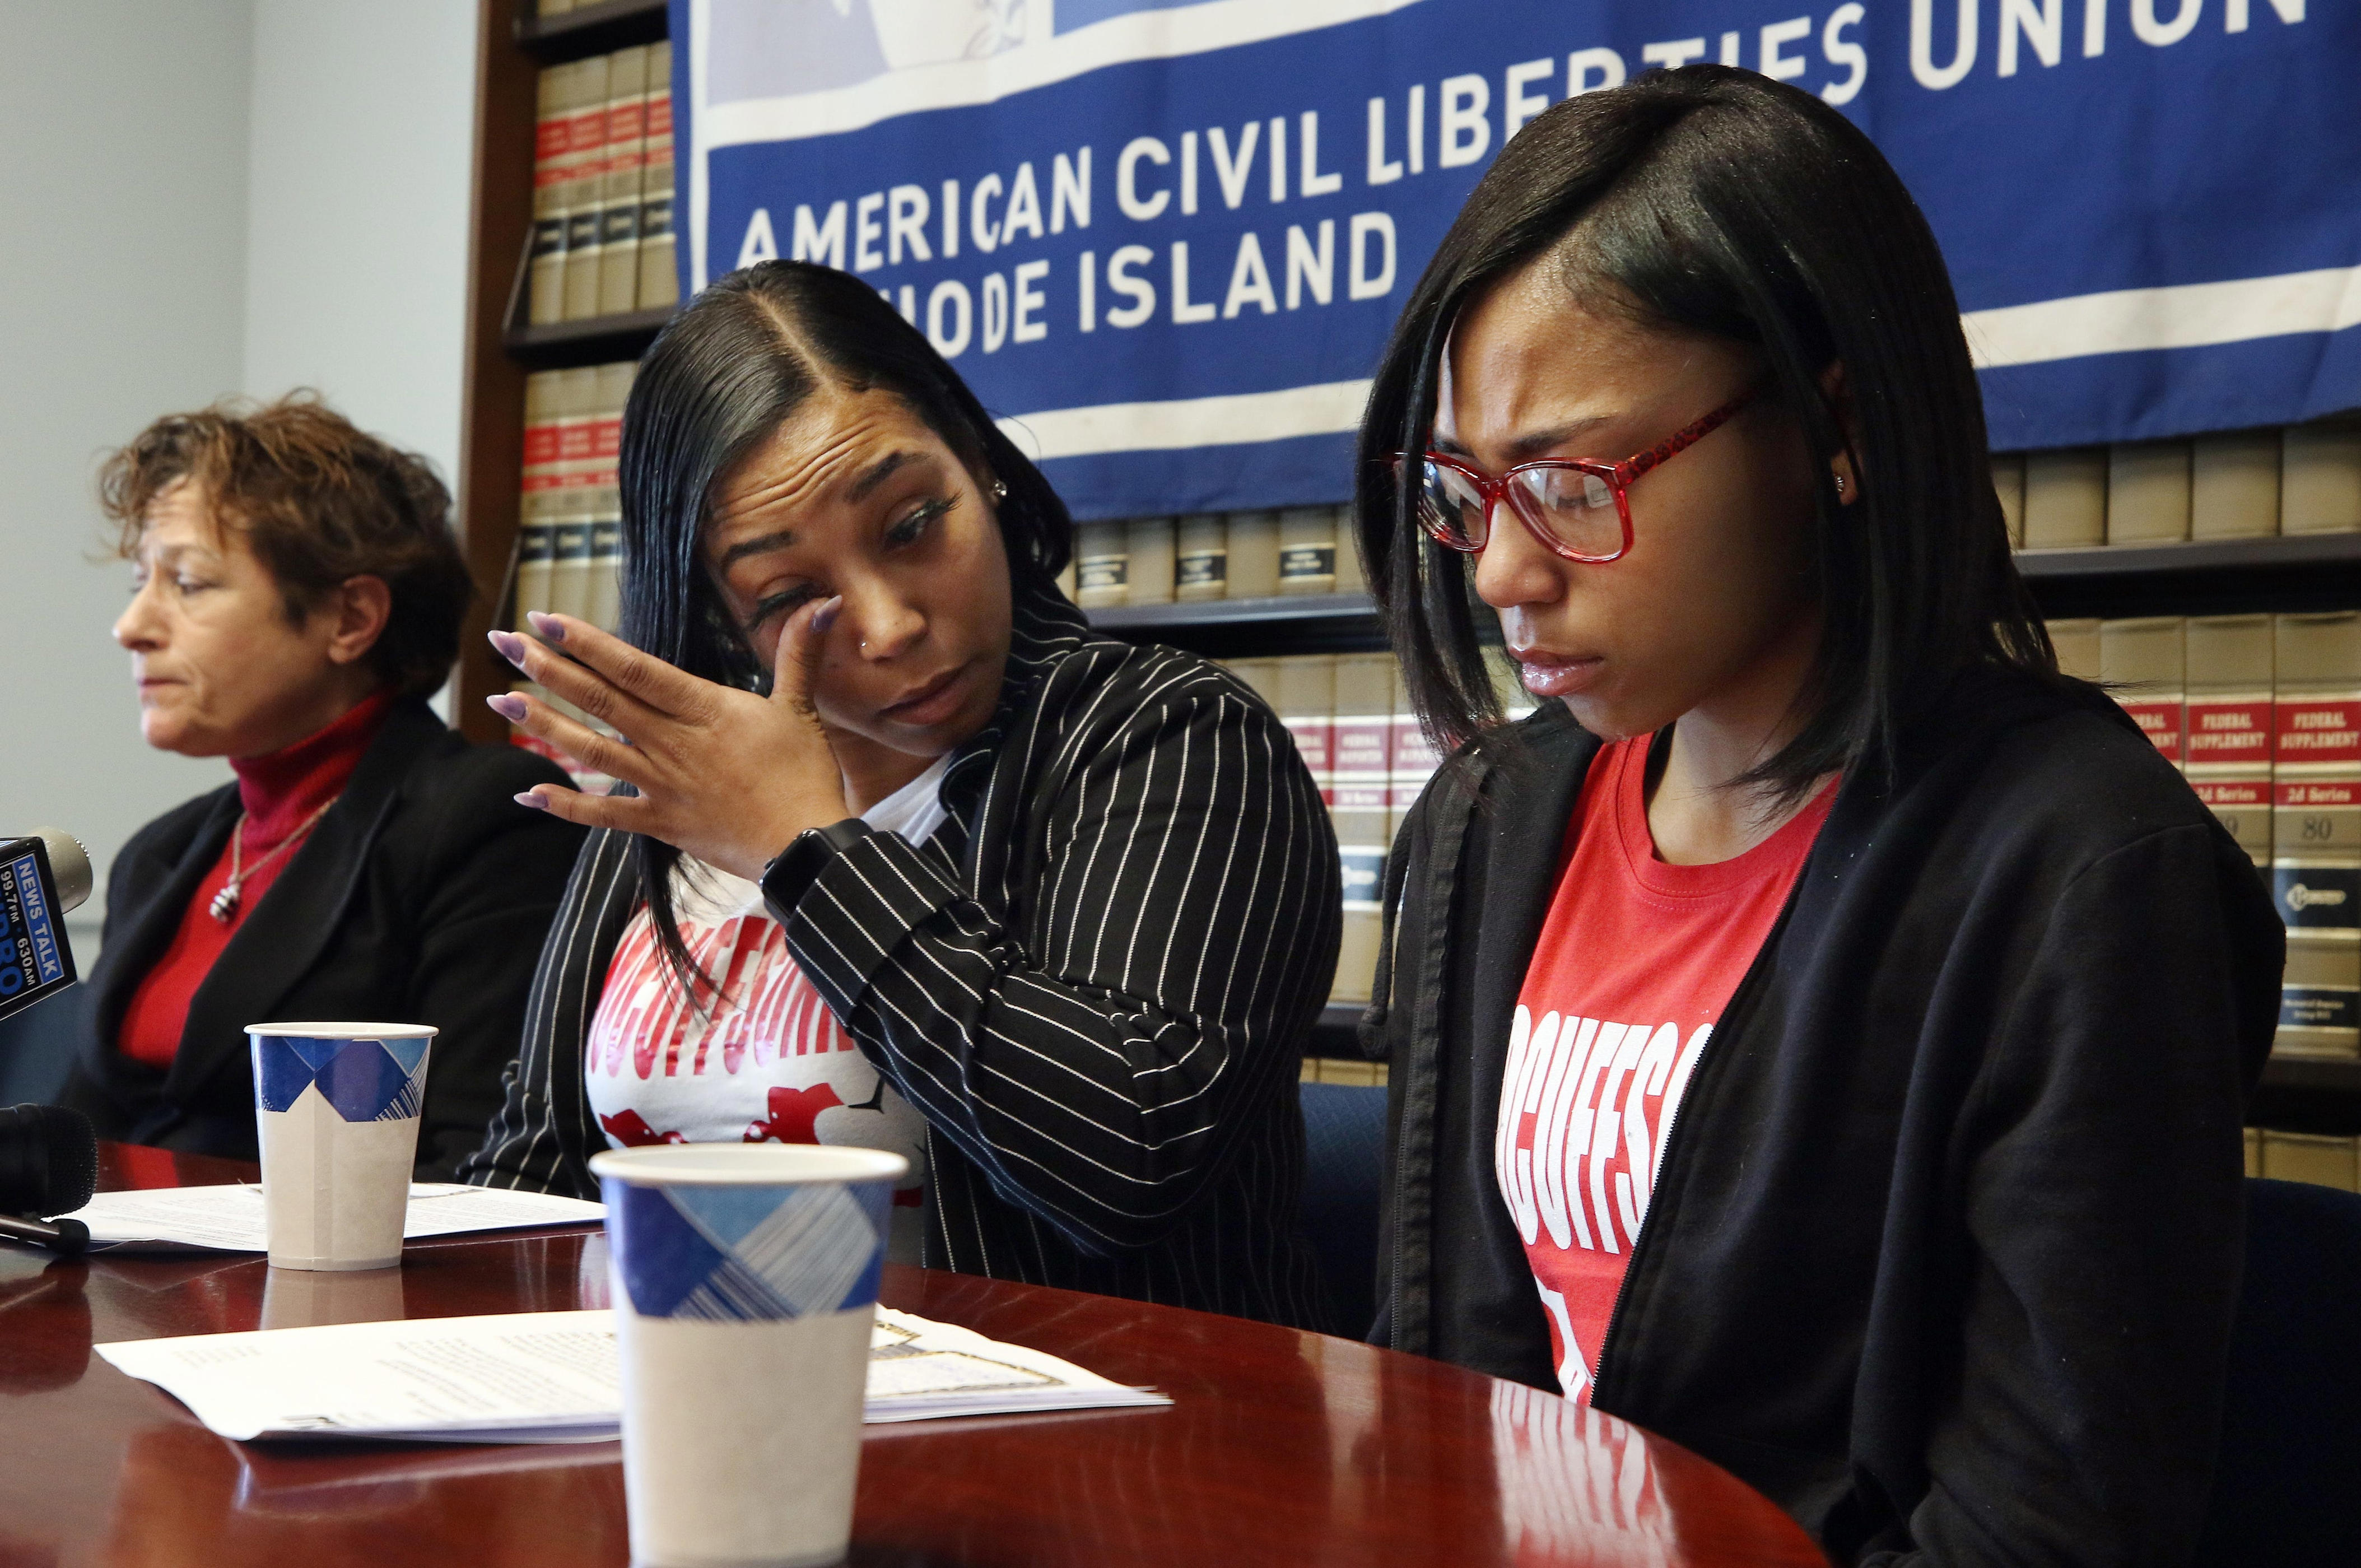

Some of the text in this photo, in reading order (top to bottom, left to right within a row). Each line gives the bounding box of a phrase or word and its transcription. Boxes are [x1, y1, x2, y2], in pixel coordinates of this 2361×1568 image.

[736, 146, 1092, 273] AMERICAN
[1116, 110, 1343, 221] CIVIL
[1079, 211, 1396, 333] ISLAND
[2202, 713, 2252, 729] FEDERAL
[2293, 711, 2348, 729] FEDERAL
[2190, 732, 2266, 750] SUPPLEMENT
[2280, 731, 2359, 750] SUPPLEMENT
[2288, 786, 2351, 803] 2d Series
[2302, 816, 2332, 840] 80
[0, 871, 36, 986] 99.7FM 630AM
[18, 862, 58, 976] NEWS TALK
